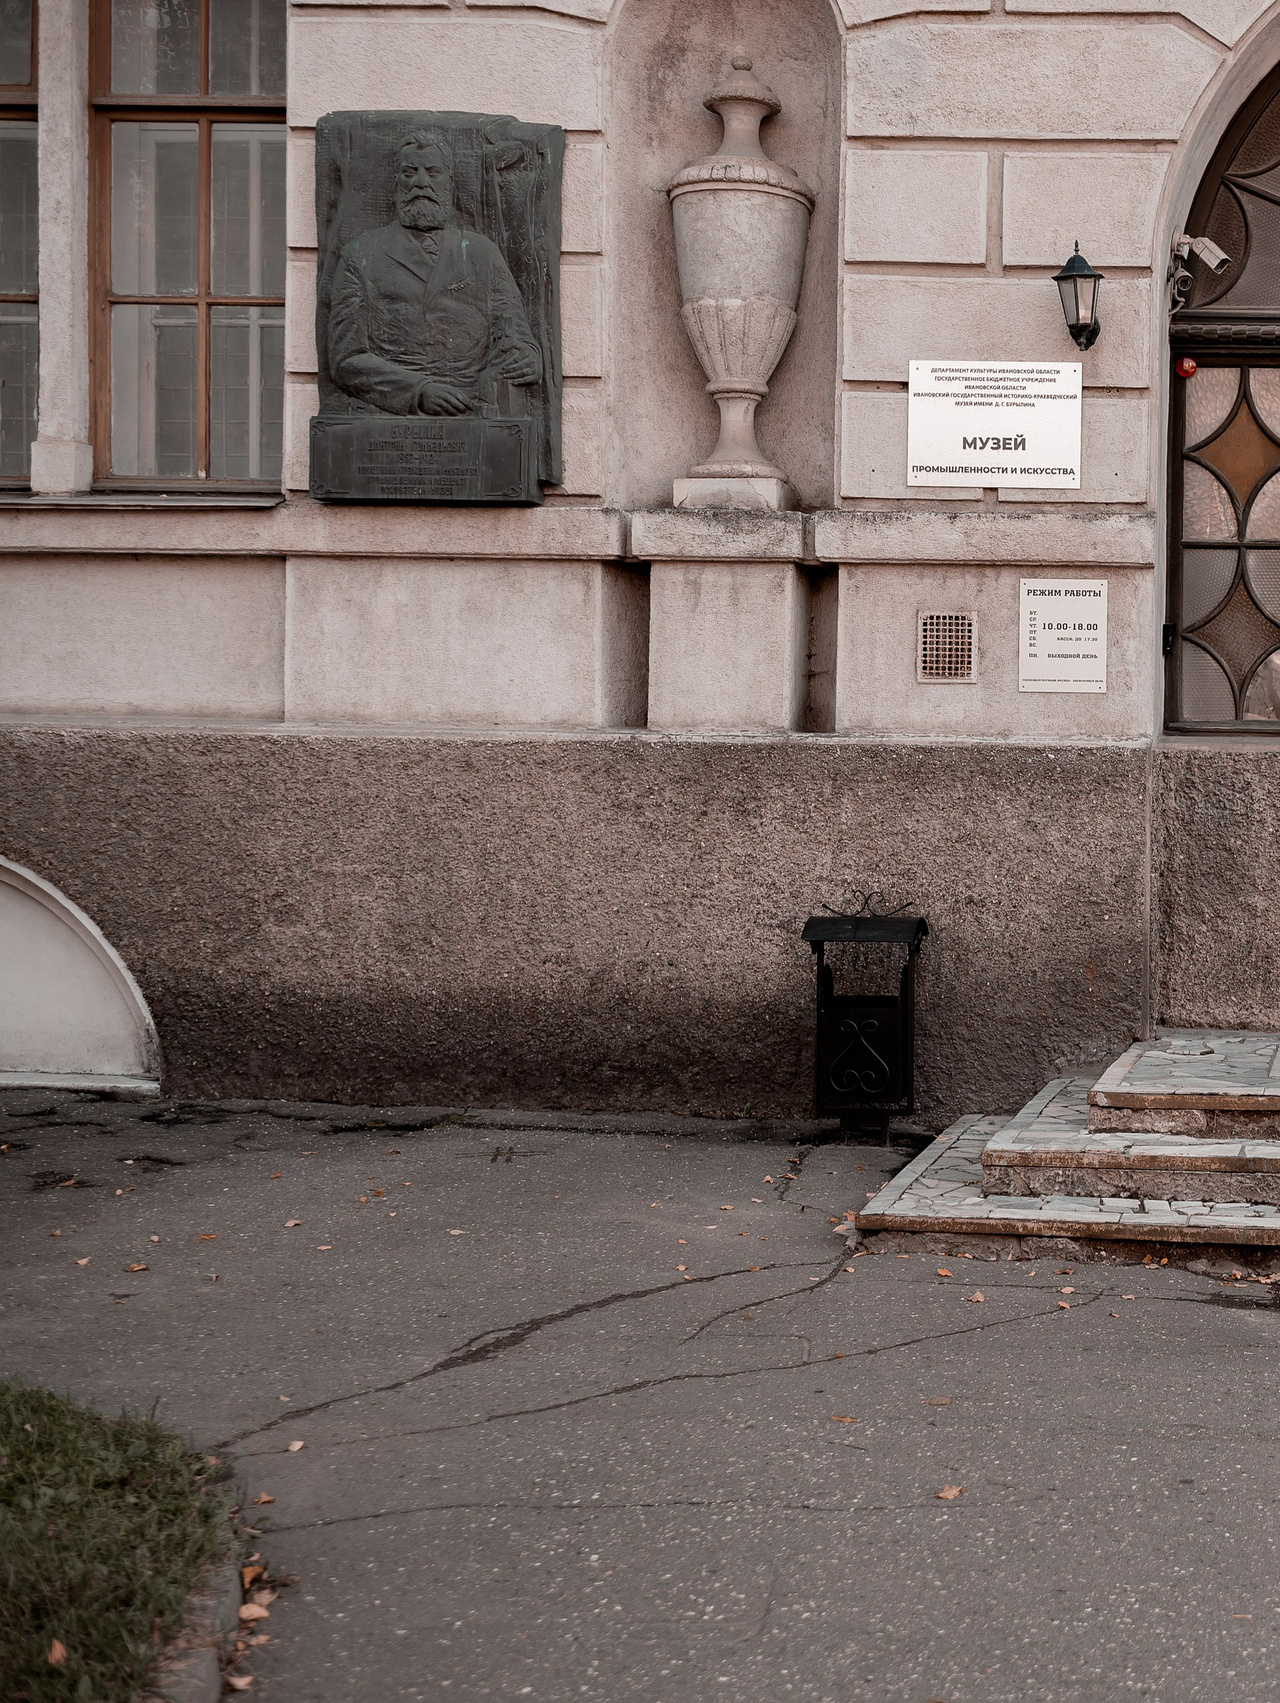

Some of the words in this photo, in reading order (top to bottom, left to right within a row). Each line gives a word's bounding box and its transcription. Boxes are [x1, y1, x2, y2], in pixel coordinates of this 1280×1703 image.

[962, 434, 1026, 451] МУЗЕЙ
[912, 466, 1008, 474] ПРОМЫШЛЕННОСТИ
[1010, 466, 1018, 474] И
[1020, 466, 1076, 476] ИСКУССТВА
[1042, 622, 1098, 631] 10.00-18.00
